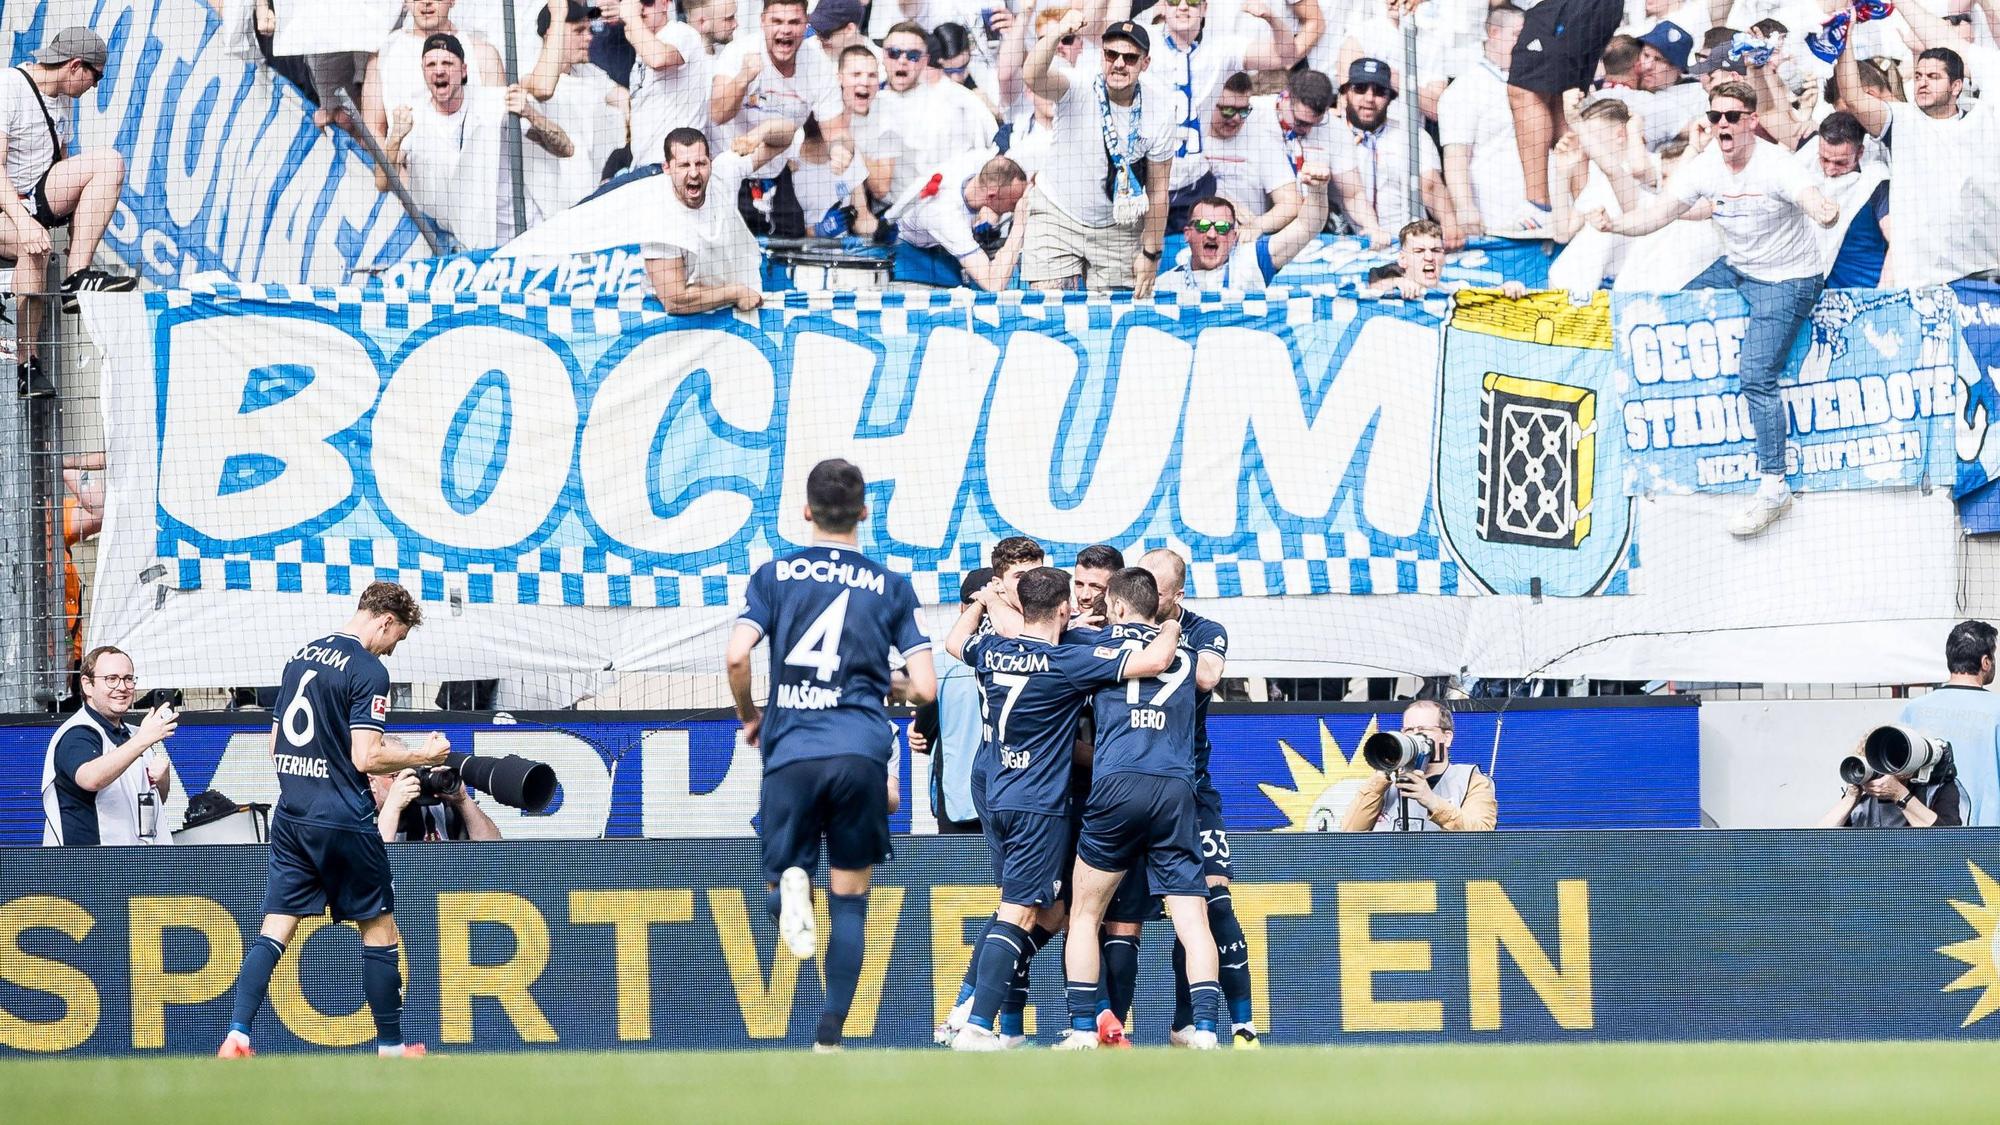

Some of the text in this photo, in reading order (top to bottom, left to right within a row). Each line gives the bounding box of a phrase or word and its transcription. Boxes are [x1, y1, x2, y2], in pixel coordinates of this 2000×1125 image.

[1629, 318, 1747, 384] GEGE
[157, 314, 1439, 556] BOCHUM
[1802, 431, 1922, 474] AUFGEBEN
[776, 558, 885, 596] BOCHUM
[784, 587, 851, 683] 4
[1118, 639, 1192, 706] 19
[282, 669, 318, 747] 6
[992, 672, 1031, 743] 7
[1131, 709, 1166, 731] BERO
[1200, 829, 1230, 858] 33
[0, 880, 1595, 1053] SPORTWETEN
